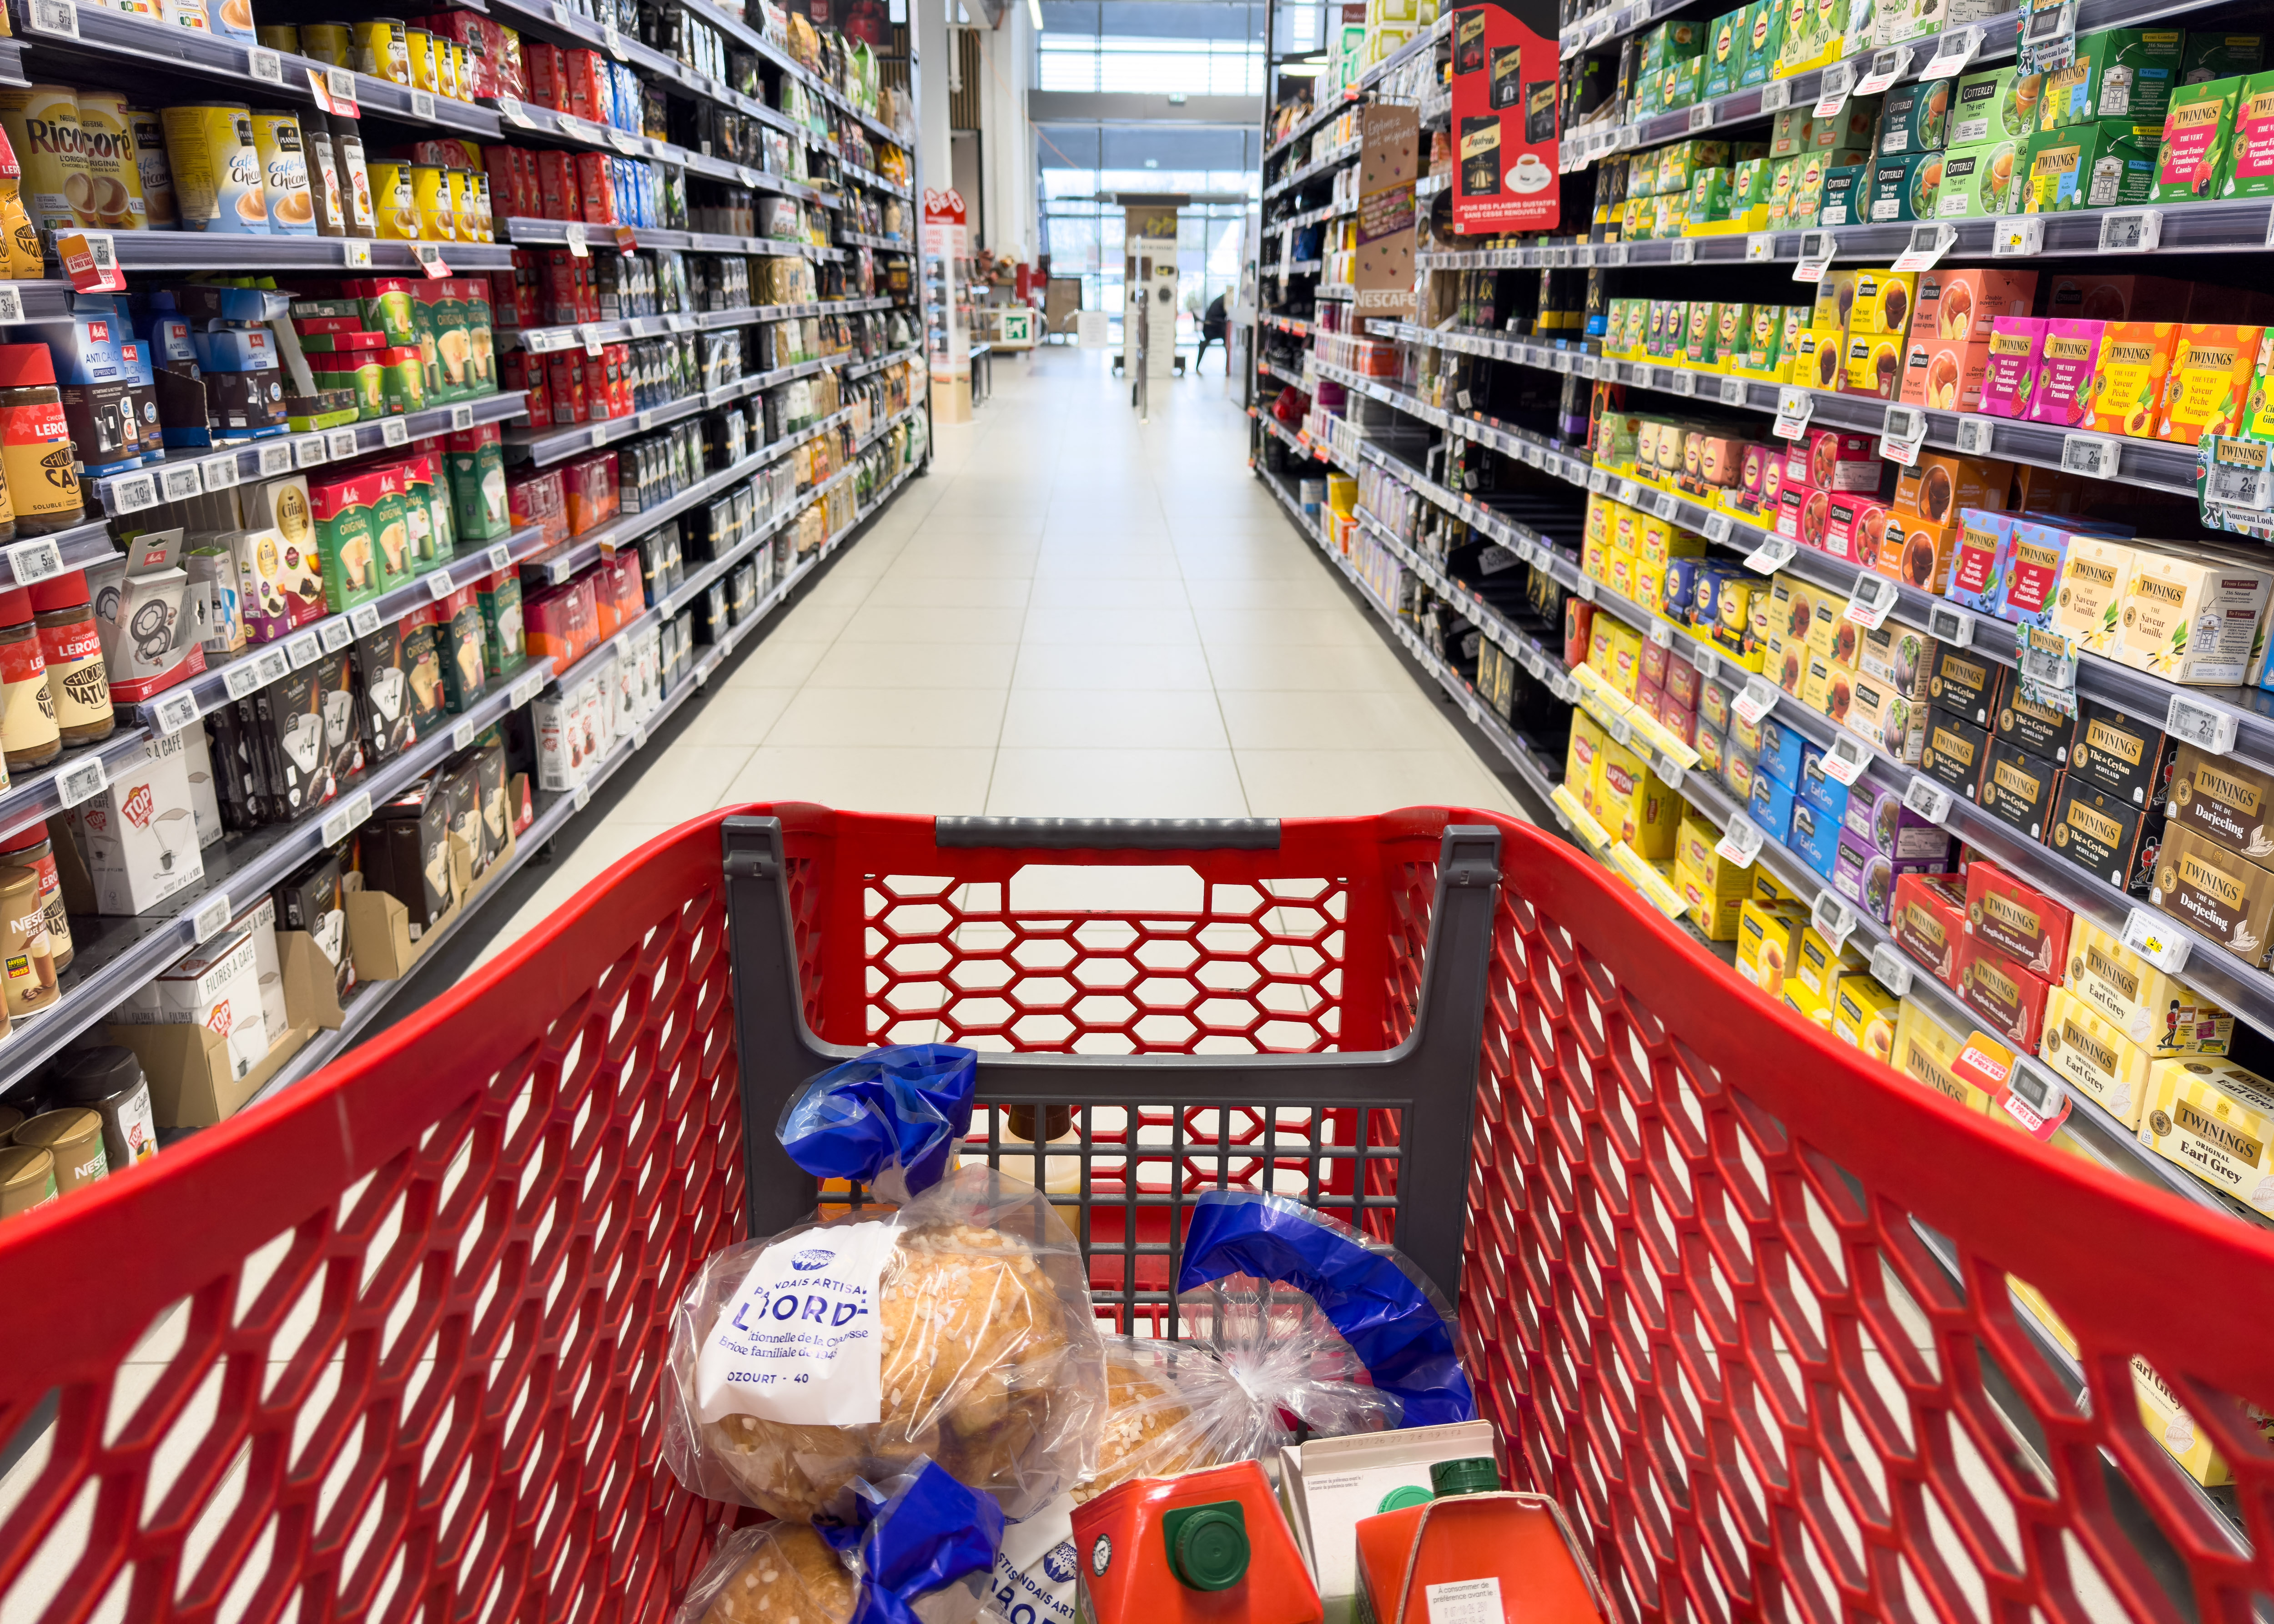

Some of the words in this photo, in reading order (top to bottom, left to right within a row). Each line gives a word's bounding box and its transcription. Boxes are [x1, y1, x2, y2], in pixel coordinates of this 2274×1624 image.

[1814, 30, 1829, 46] BIO
[1786, 41, 1799, 55] BIO
[2036, 50, 2058, 62] Nouveau
[1964, 85, 1995, 99] COTTERLEY
[1890, 100, 1913, 113] COTTERLEY
[1967, 103, 1975, 111] Thé
[2178, 106, 2218, 123] TWININGS
[2038, 153, 2075, 169] TWININGS
[2173, 156, 2199, 166] Framboise
[1827, 178, 1851, 190] COTTERLEY
[1522, 200, 1556, 208] GUSTATIFS
[1921, 287, 1940, 299] COTTERLEY
[86, 353, 101, 364] ANTI
[102, 351, 119, 362] CALC
[2111, 345, 2150, 361] TWININGS
[2189, 351, 2233, 365] TWININGS
[2049, 381, 2075, 392] Framboise
[2191, 385, 2213, 395] Saveur
[2051, 390, 2070, 400] Passion
[2189, 396, 2209, 406] Pêche
[2184, 406, 2210, 417] Mangue
[2222, 445, 2263, 461] TWININGS
[33, 502, 62, 510] SOLUBLE
[1831, 506, 1852, 523] COTTERLEY
[2226, 510, 2255, 523] Nouveau
[2019, 546, 2055, 564] TWININGS
[2075, 563, 2113, 583] TWININGS
[2019, 583, 2040, 597] Myrtille
[2141, 579, 2183, 603] TWININGS
[2075, 593, 2098, 607] Saveur
[2073, 603, 2096, 618] Vanille
[2140, 613, 2165, 628] Saveur
[2138, 623, 2163, 639] Vanille
[141, 686, 148, 695] 18
[162, 730, 181, 757] CAFÉ
[2093, 727, 2137, 757] TWININGS
[2090, 749, 2101, 763] Thé
[2107, 759, 2130, 775] Ceylan
[1606, 762, 1634, 795] LIPTON
[2095, 764, 2120, 779] SCOTLAND
[2200, 771, 2254, 806] TWININGS
[125, 788, 150, 820] TOP
[2211, 801, 2223, 812] THÉ
[2223, 806, 2233, 815] DU
[135, 805, 154, 828] BUDGET
[2195, 803, 2244, 840] Darjeeling
[2180, 892, 2229, 932] Darjeeling
[1982, 924, 2004, 941] English
[2005, 937, 2034, 958] Breakfast
[10, 967, 28, 978] 2025
[206, 965, 228, 995] FILTRES
[239, 939, 255, 970] CAFÉ
[2098, 981, 2118, 1000] ORIGINAL
[2089, 983, 2107, 1003] Earl
[2106, 996, 2125, 1020] Grey
[1973, 1058, 1987, 1071] PRIX
[1989, 1068, 2003, 1079] BAS
[2183, 1108, 2254, 1158] TWININGS
[2209, 1137, 2230, 1151] LONDON
[2196, 1141, 2229, 1163] ORIGINAL
[2180, 1140, 2208, 1165] Earl
[2210, 1158, 2242, 1184] Grey
[798, 1332, 811, 1342] de
[813, 1335, 823, 1346] la
[750, 1347, 796, 1358] familiale
[727, 1372, 777, 1383] OZOURT
[794, 1373, 809, 1383] 40
[2155, 1376, 2183, 1410] Grey
[2155, 1396, 2173, 1414] BERGAMOTE
[1444, 1584, 1479, 1593] consommer
[1433, 1594, 1466, 1604] préférence
